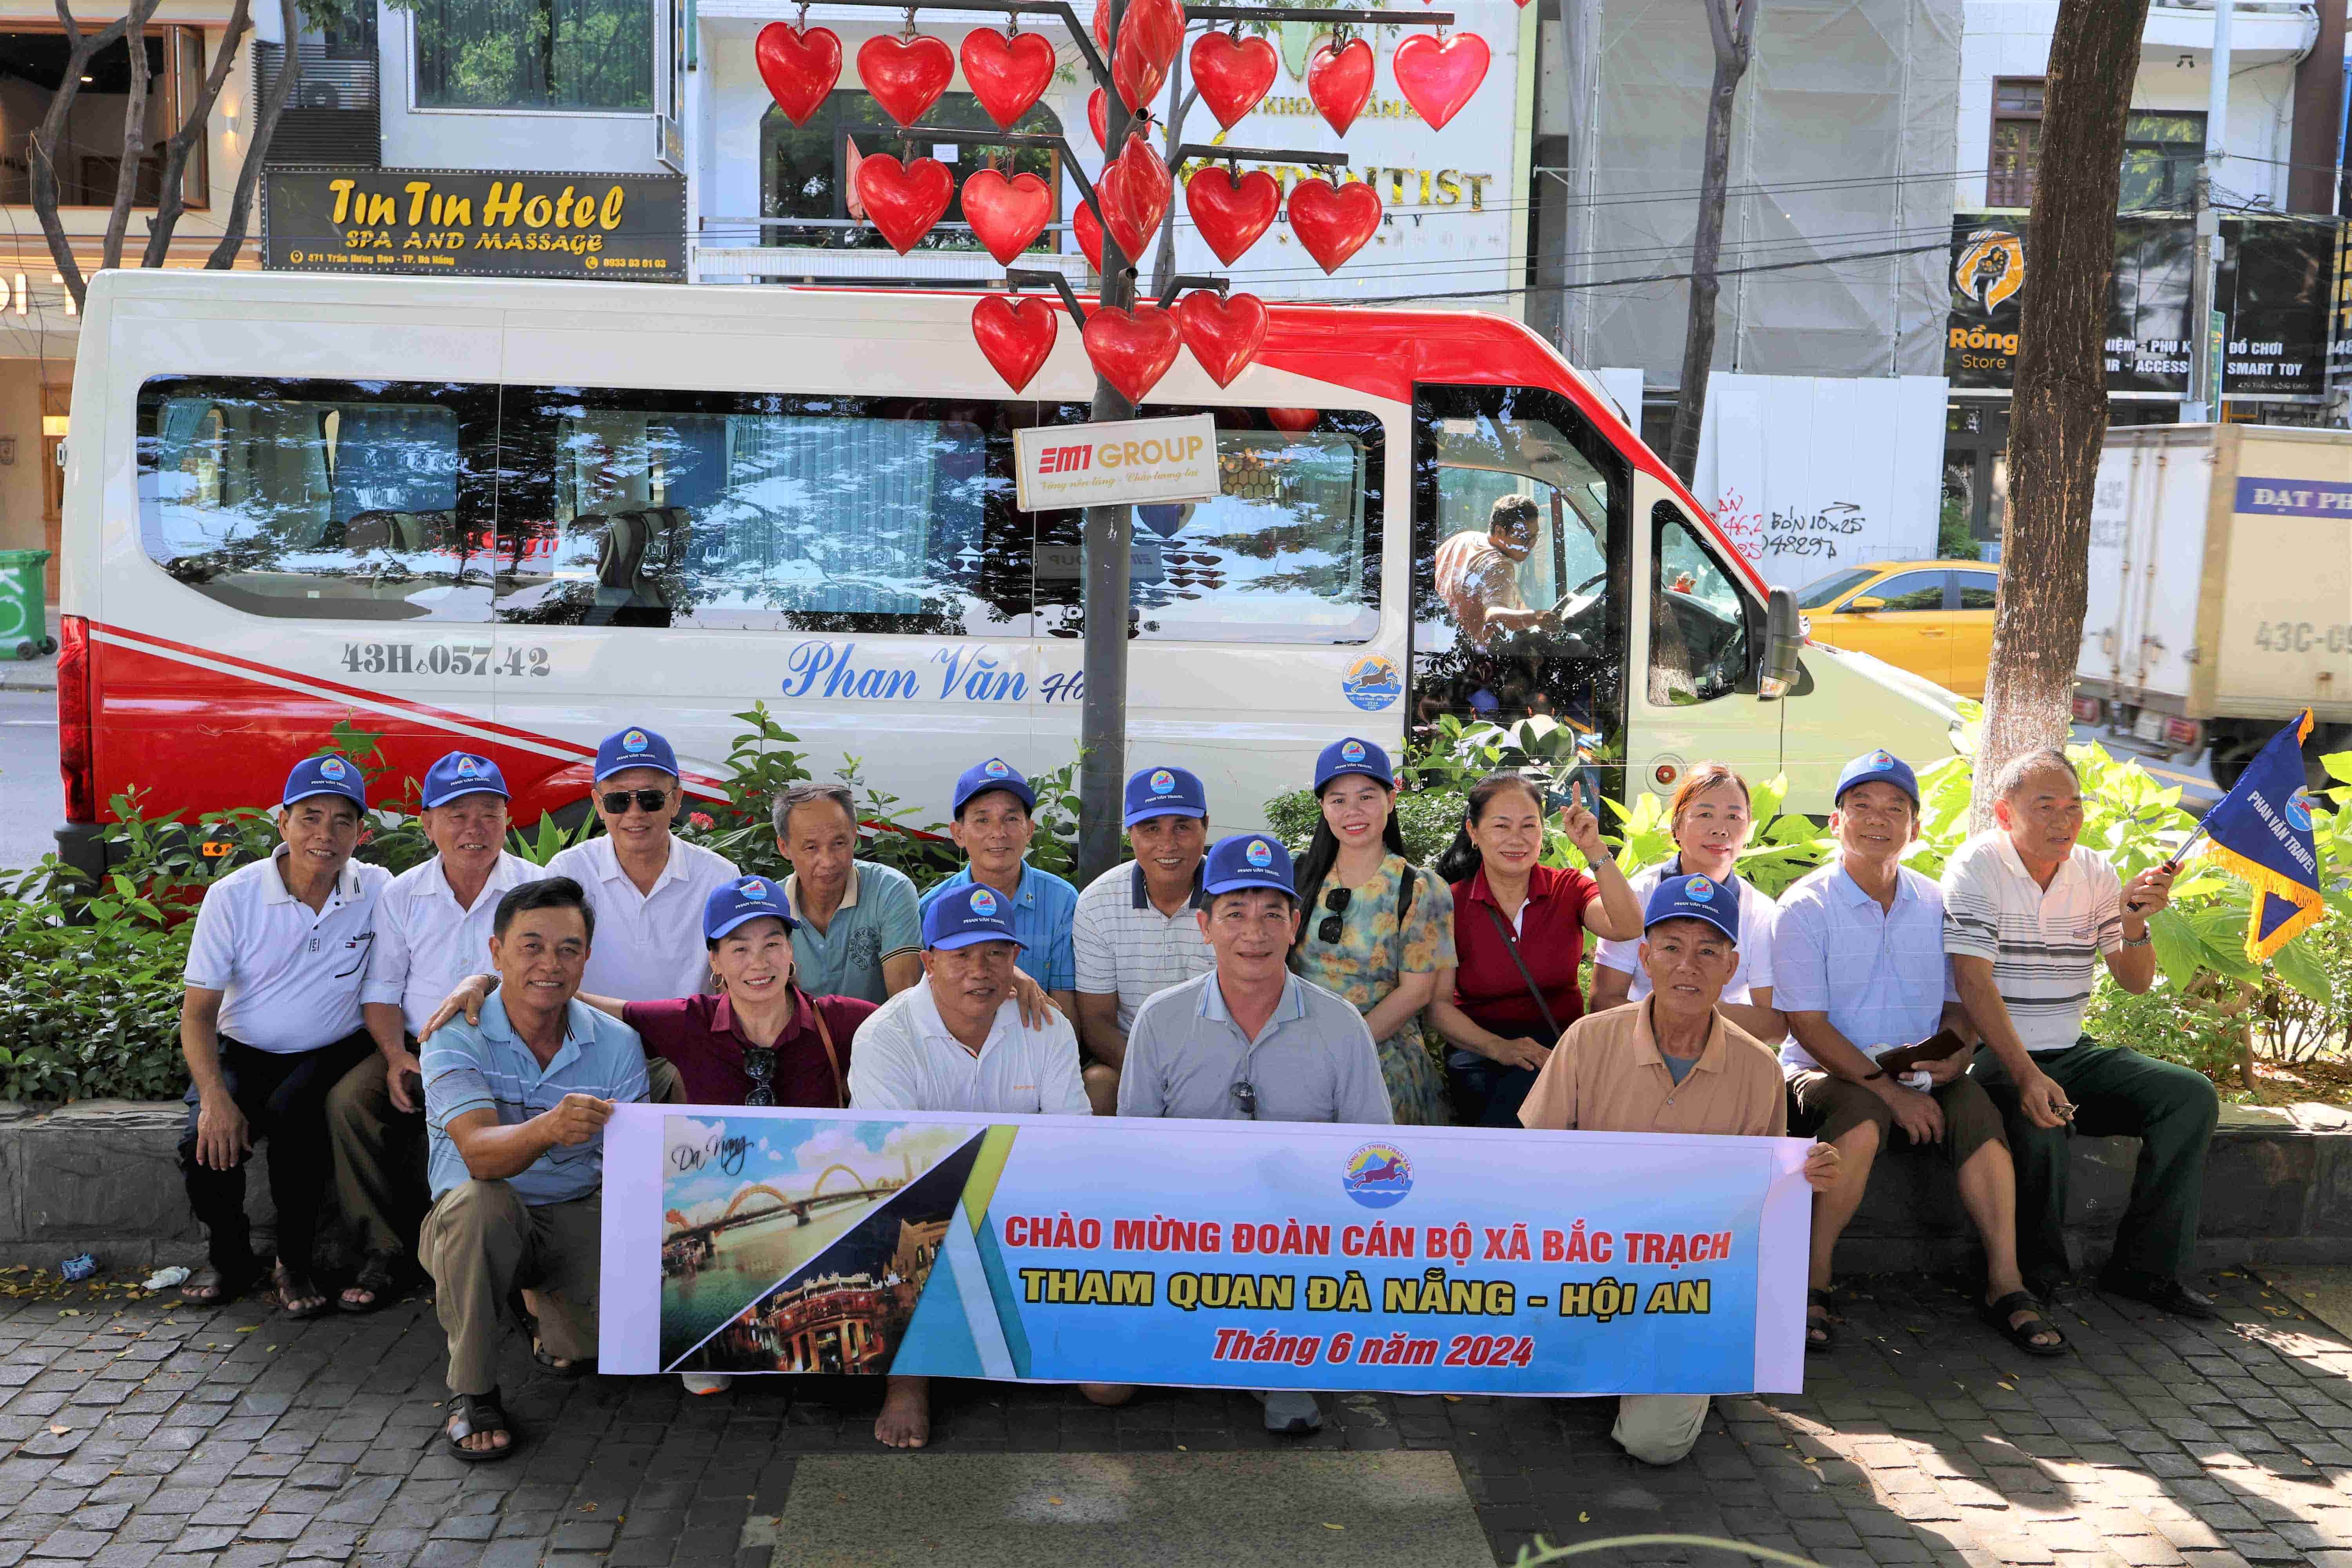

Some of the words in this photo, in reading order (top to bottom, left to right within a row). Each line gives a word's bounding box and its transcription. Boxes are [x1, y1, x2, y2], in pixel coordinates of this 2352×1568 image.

[1263, 96, 1316, 115] KHO
[329, 180, 397, 227] Tin
[404, 181, 472, 227] Tin
[482, 181, 624, 230] Hotel
[345, 230, 394, 248] SPA
[403, 232, 465, 250] AND
[474, 232, 603, 255] MASSAGE
[1949, 325, 2018, 355] Rồng
[2151, 339, 2178, 355] PHỤ
[2229, 338, 2246, 355] ĐỒ
[2251, 340, 2283, 356] CHƠI
[1960, 355, 2006, 370] Store
[2136, 359, 2190, 372] ACCESS
[2227, 363, 2272, 375] SMART
[2279, 363, 2302, 376] TOY
[1098, 436, 1203, 468] GROUP
[782, 640, 920, 699] Phan
[930, 644, 1029, 701] Văn
[2247, 790, 2271, 823] PHAN
[2268, 815, 2287, 841] VĂN
[2284, 834, 2316, 875] TRAVEL
[1264, 869, 1280, 877] TRAVEL
[1701, 904, 1720, 914] TRAVEL
[1388, 1145, 1405, 1158] PHAN
[1005, 1212, 1101, 1249] CHÀO
[1113, 1214, 1221, 1252] MỪNG
[1232, 1218, 1330, 1255] ĐOÀN
[1341, 1220, 1415, 1258] CÁN
[1426, 1222, 1472, 1266] BỘ
[1483, 1223, 1531, 1261] XÃ
[1542, 1219, 1613, 1263] BẮC
[1624, 1231, 1732, 1269] TRẠCH
[1020, 1268, 1155, 1306] THAM
[1167, 1272, 1294, 1311] QUAN
[1306, 1270, 1371, 1312] ĐÀ
[1383, 1267, 1515, 1315] NẴNG
[1527, 1296, 1548, 1308] -
[1559, 1276, 1638, 1323] HỘI
[1644, 1279, 1710, 1314] AN
[1213, 1329, 1321, 1366] Tháng
[1328, 1333, 1354, 1363] 6
[1358, 1333, 1438, 1366] năm
[1443, 1335, 1535, 1367] 2024
